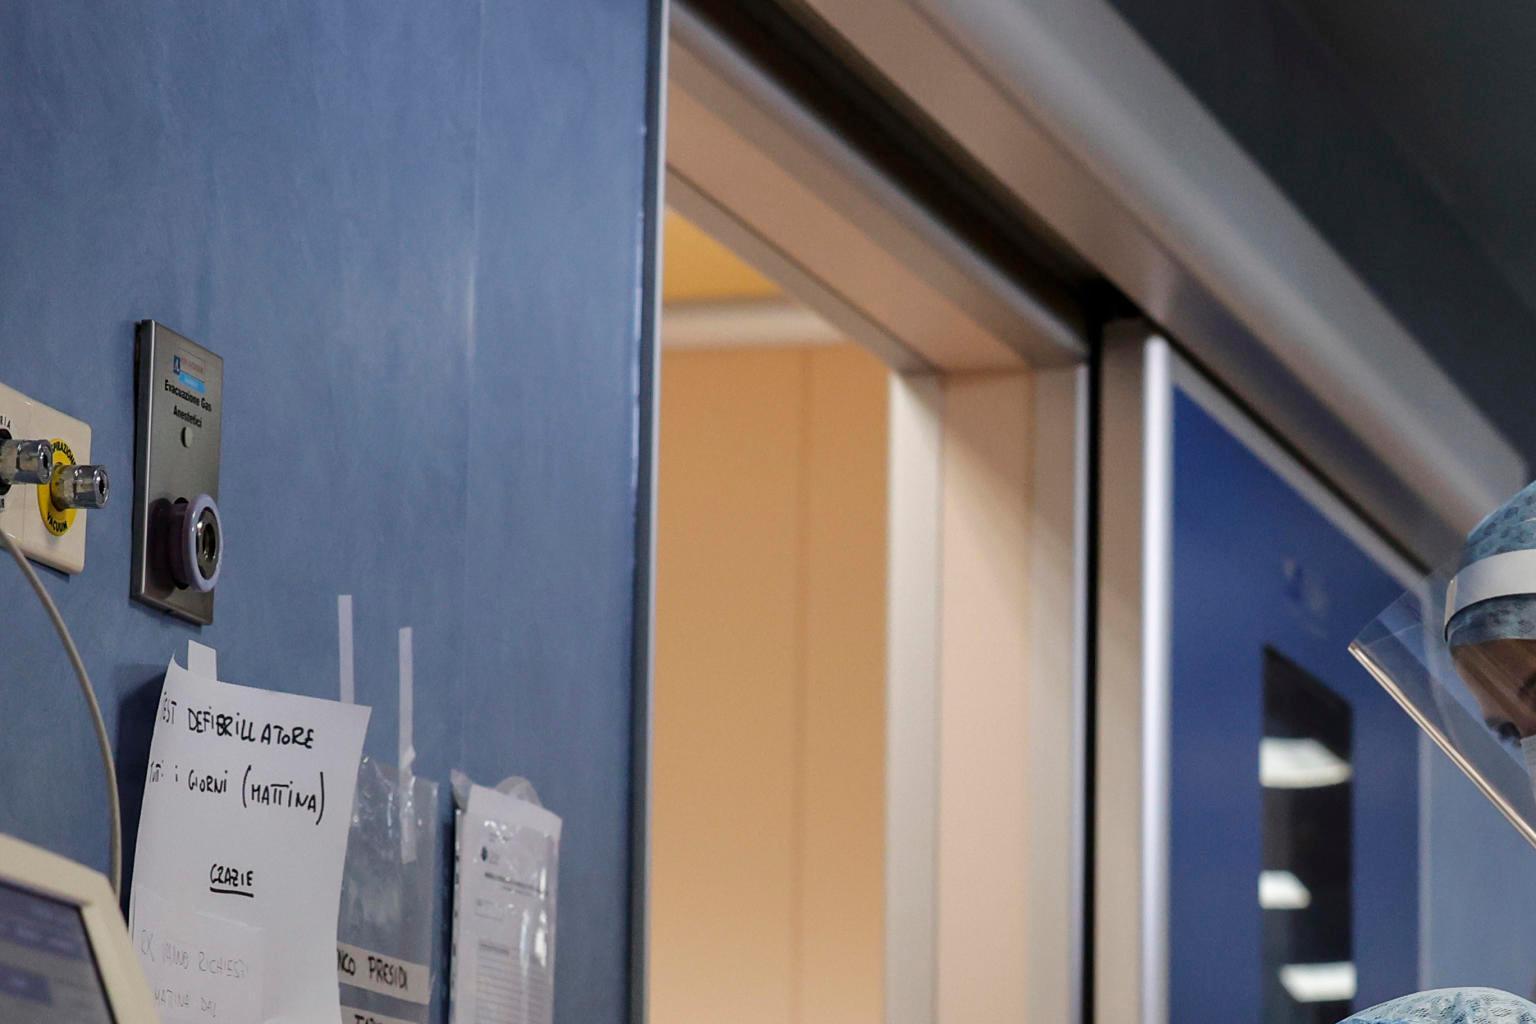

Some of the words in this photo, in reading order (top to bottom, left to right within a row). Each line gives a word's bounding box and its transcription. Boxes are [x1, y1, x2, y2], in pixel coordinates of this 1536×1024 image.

[164, 379, 200, 407] Evacuazione
[200, 397, 212, 413] Gas
[47, 511, 69, 533] VACUUM
